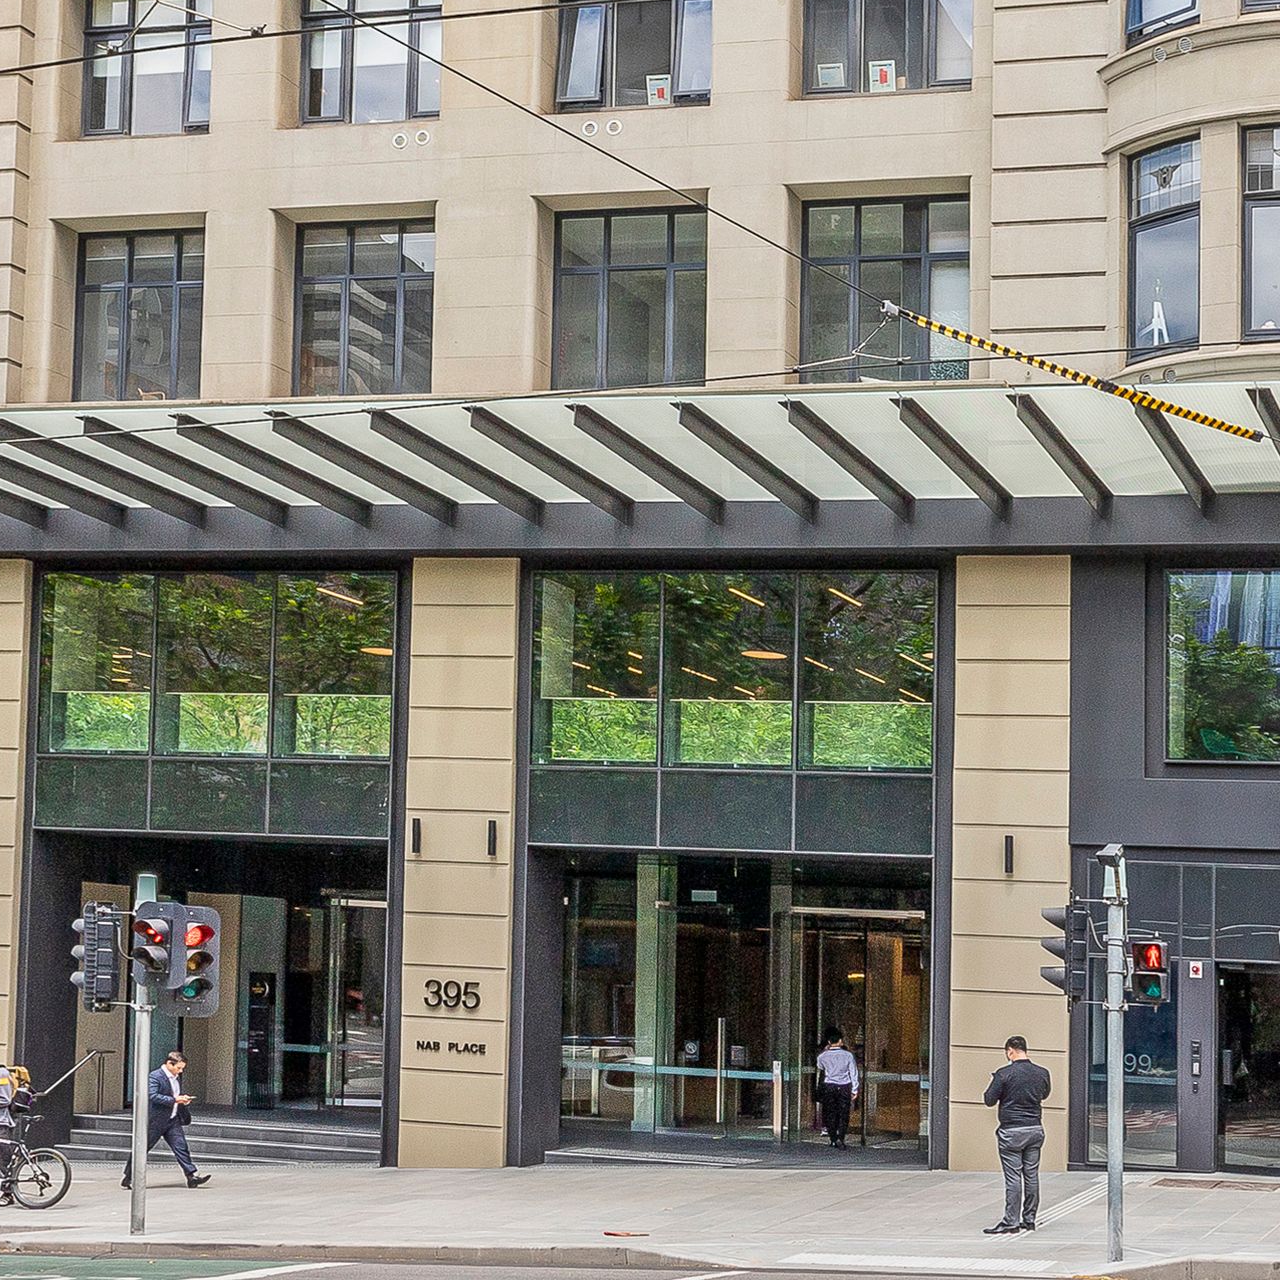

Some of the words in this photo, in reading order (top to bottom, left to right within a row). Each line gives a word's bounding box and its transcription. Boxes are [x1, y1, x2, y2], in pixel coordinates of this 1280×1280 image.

[423, 979, 482, 1010] 395
[416, 1040, 441, 1051] NAB
[447, 1042, 487, 1054] PLACE
[1123, 1053, 1152, 1073] 99
